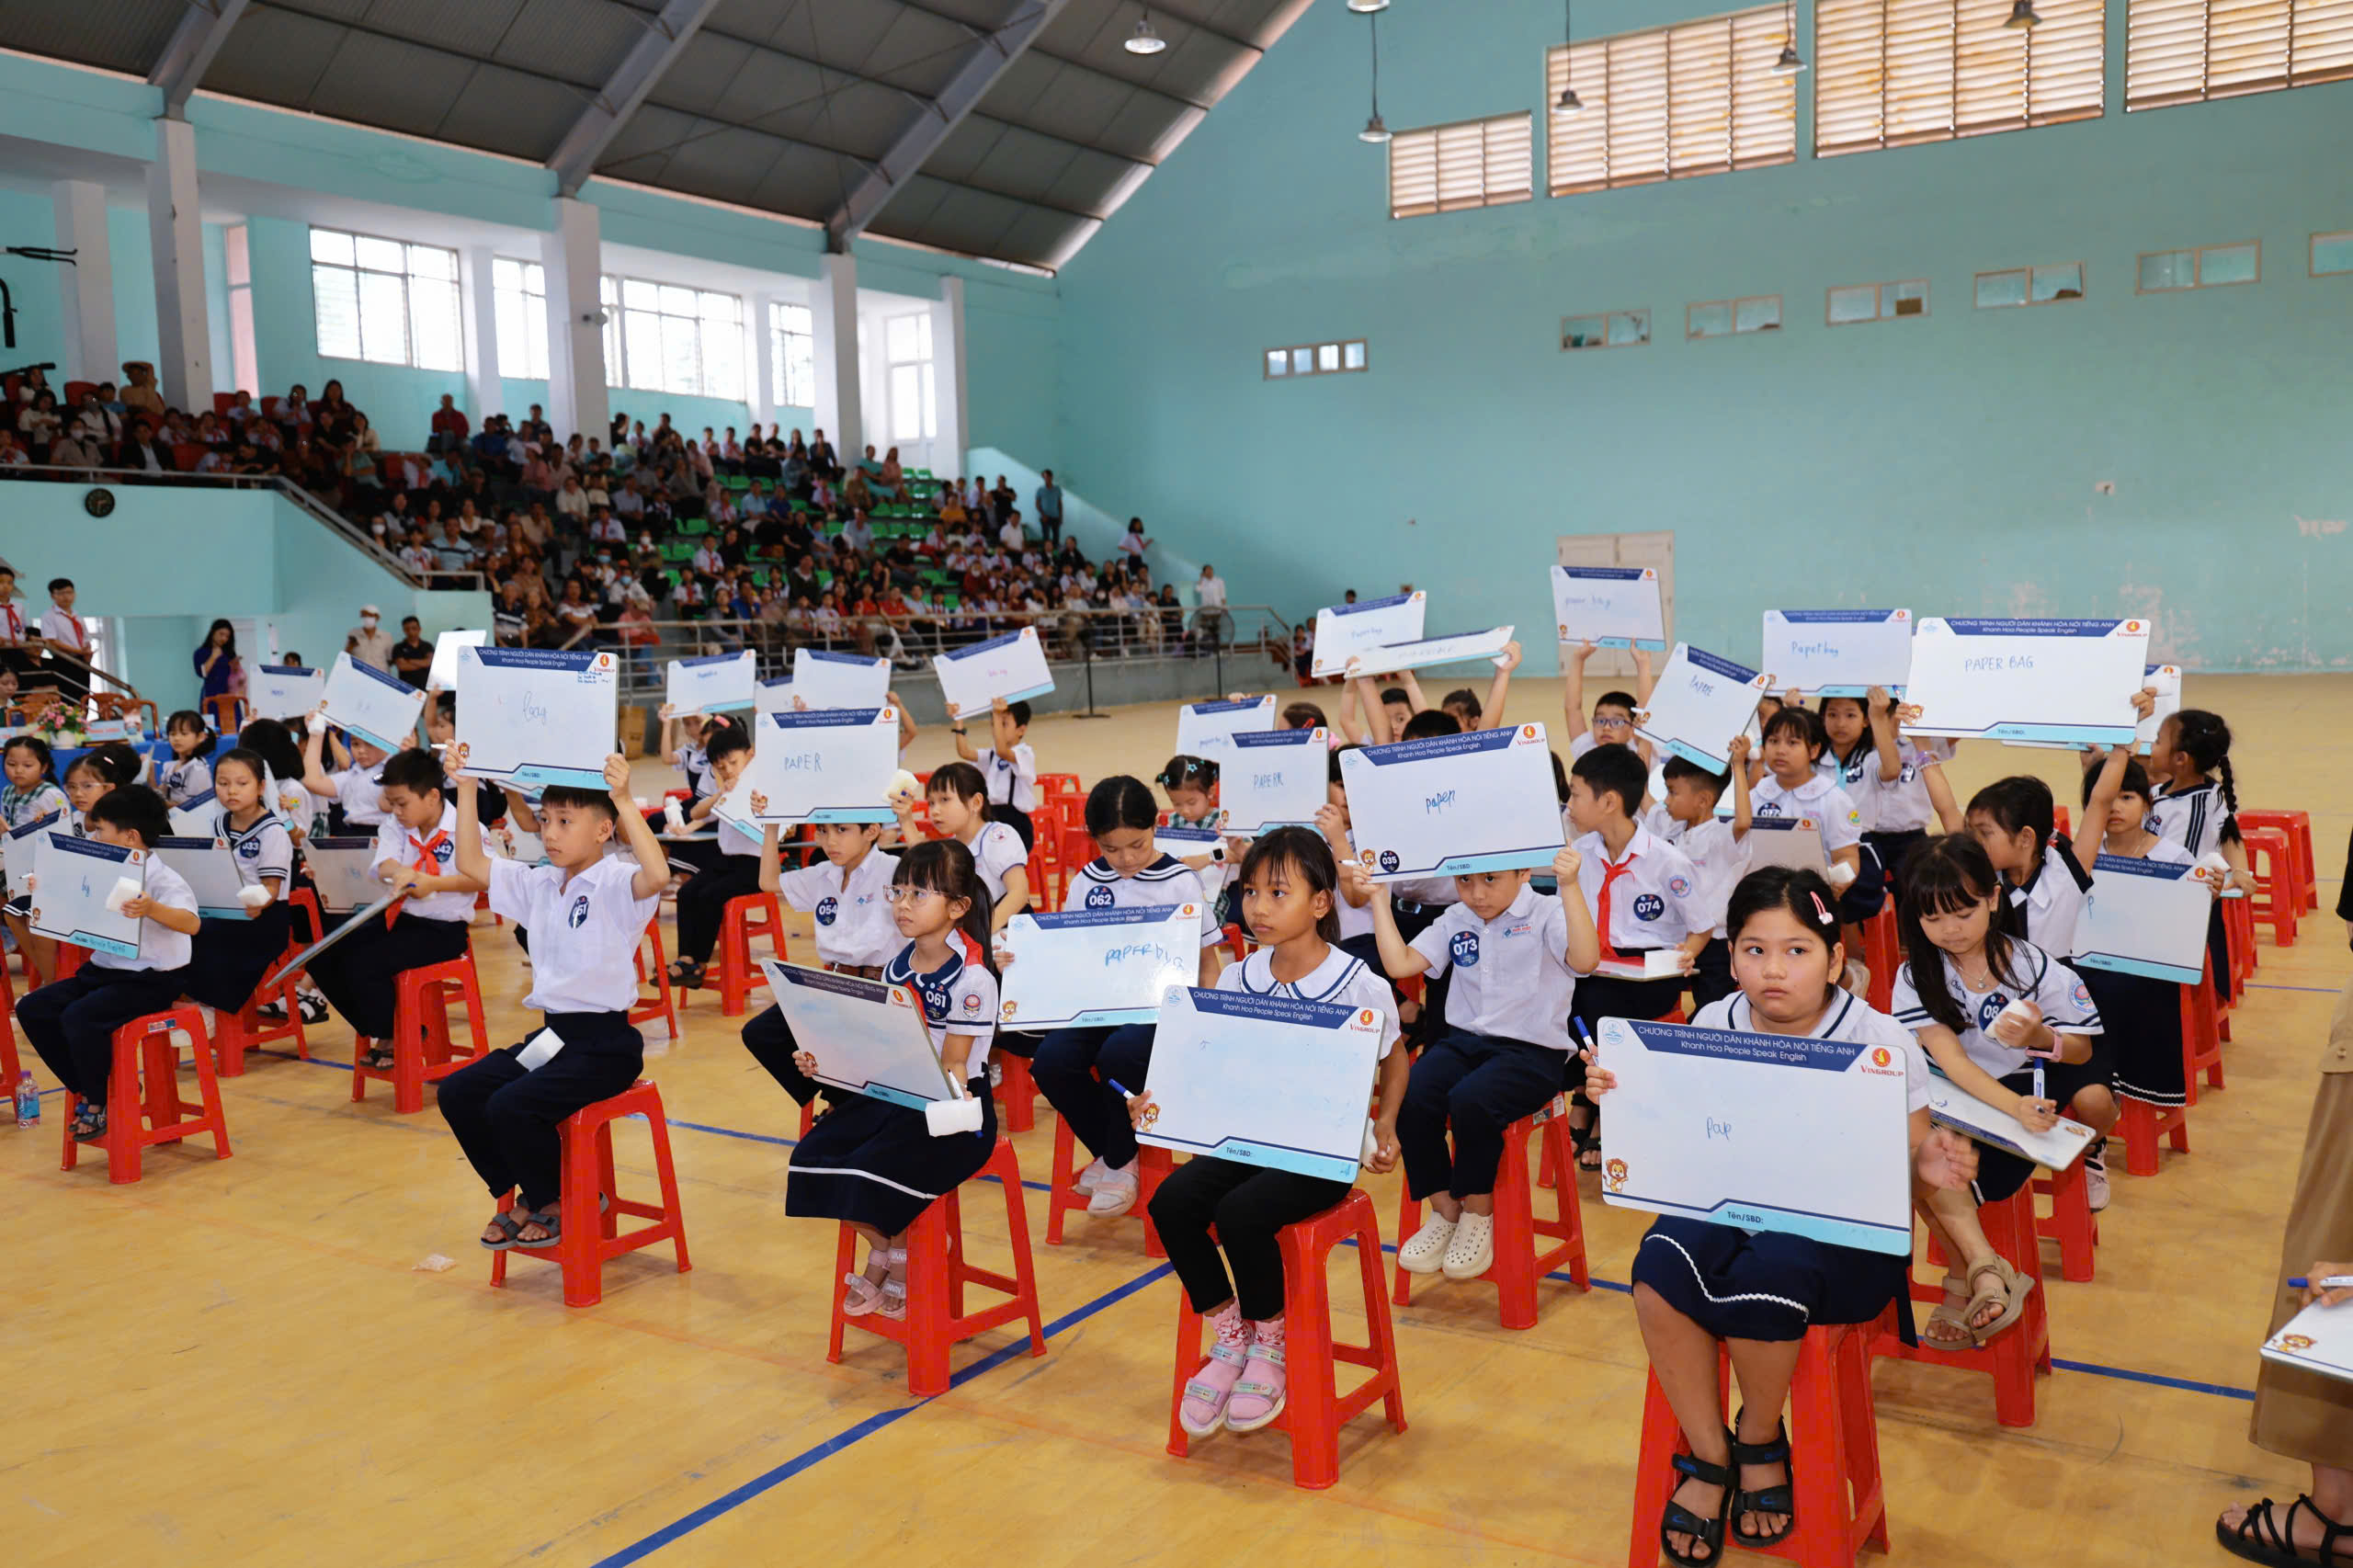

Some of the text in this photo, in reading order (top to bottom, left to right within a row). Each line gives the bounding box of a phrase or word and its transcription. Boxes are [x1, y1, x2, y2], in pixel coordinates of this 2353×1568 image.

[1964, 655, 2035, 672] PAPER BAG
[784, 752, 823, 772] PAPER
[1381, 854, 1398, 865] 035
[1088, 893, 1112, 906] 062
[1637, 899, 1662, 914] 074
[818, 903, 837, 915] 054
[1453, 938, 1478, 956] 073
[926, 990, 947, 1008] 061
[1638, 1026, 1856, 1056] CHƯƠNG TRÌNH NGƯỜI DÂN KHÁNH HÒA NÓI TIẾNG ANH
[1680, 1040, 1807, 1062] Khanh Hoa People Speak English
[1860, 1064, 1904, 1077] VINGROUP
[1726, 1210, 1764, 1225] Tên/SBD:
